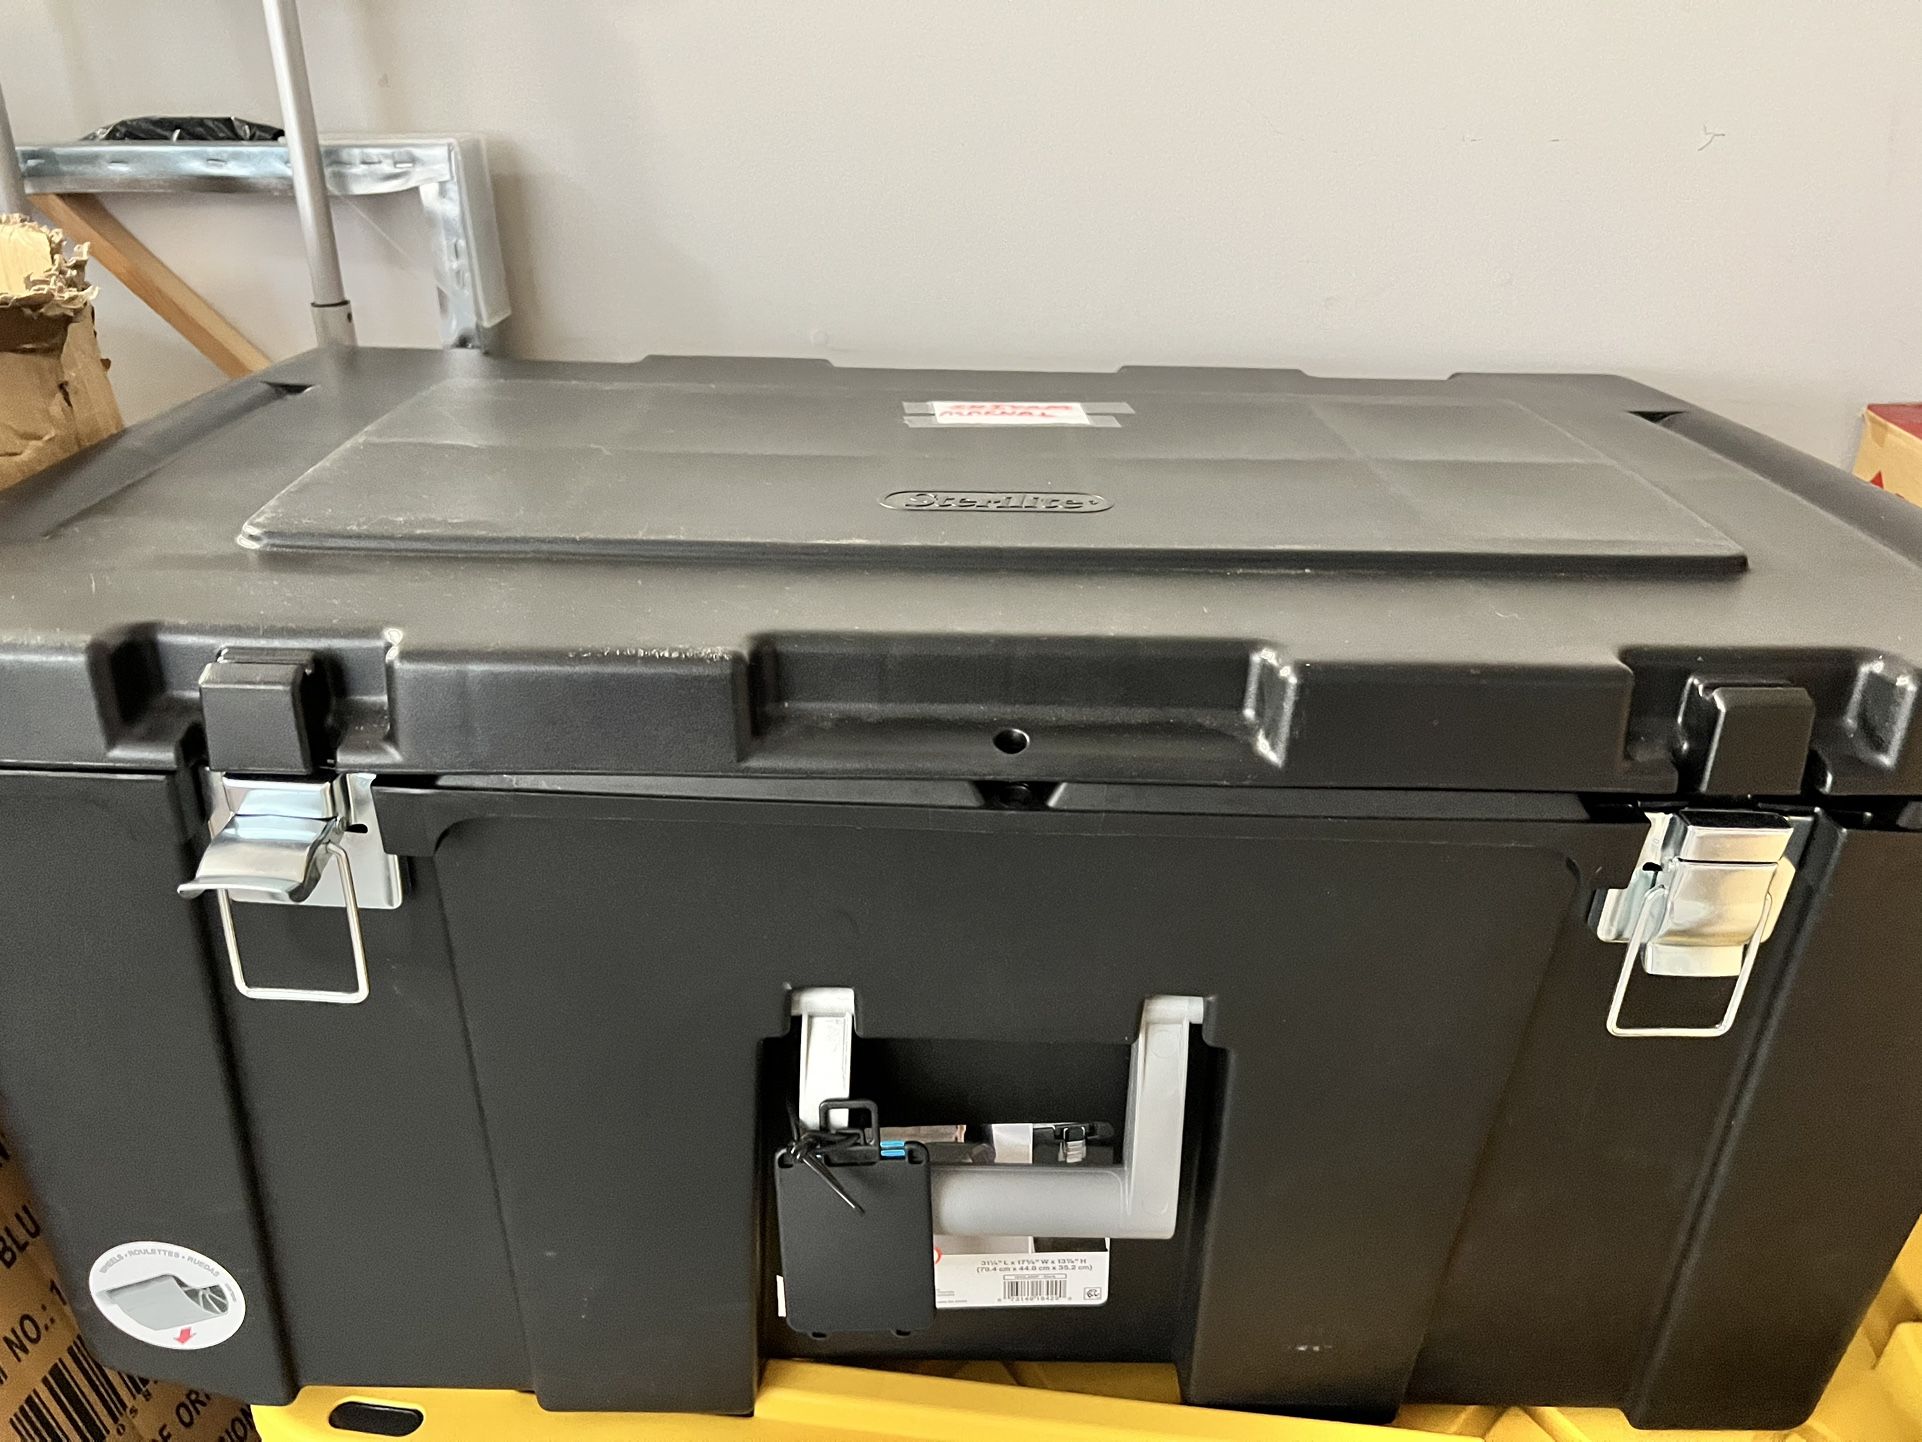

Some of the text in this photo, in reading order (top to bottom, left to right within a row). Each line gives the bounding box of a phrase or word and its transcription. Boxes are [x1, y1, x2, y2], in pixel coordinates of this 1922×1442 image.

[127, 1248, 181, 1259] ROULETTES
[187, 1256, 220, 1278] RUEDAS
[175, 1389, 212, 1428] OR
